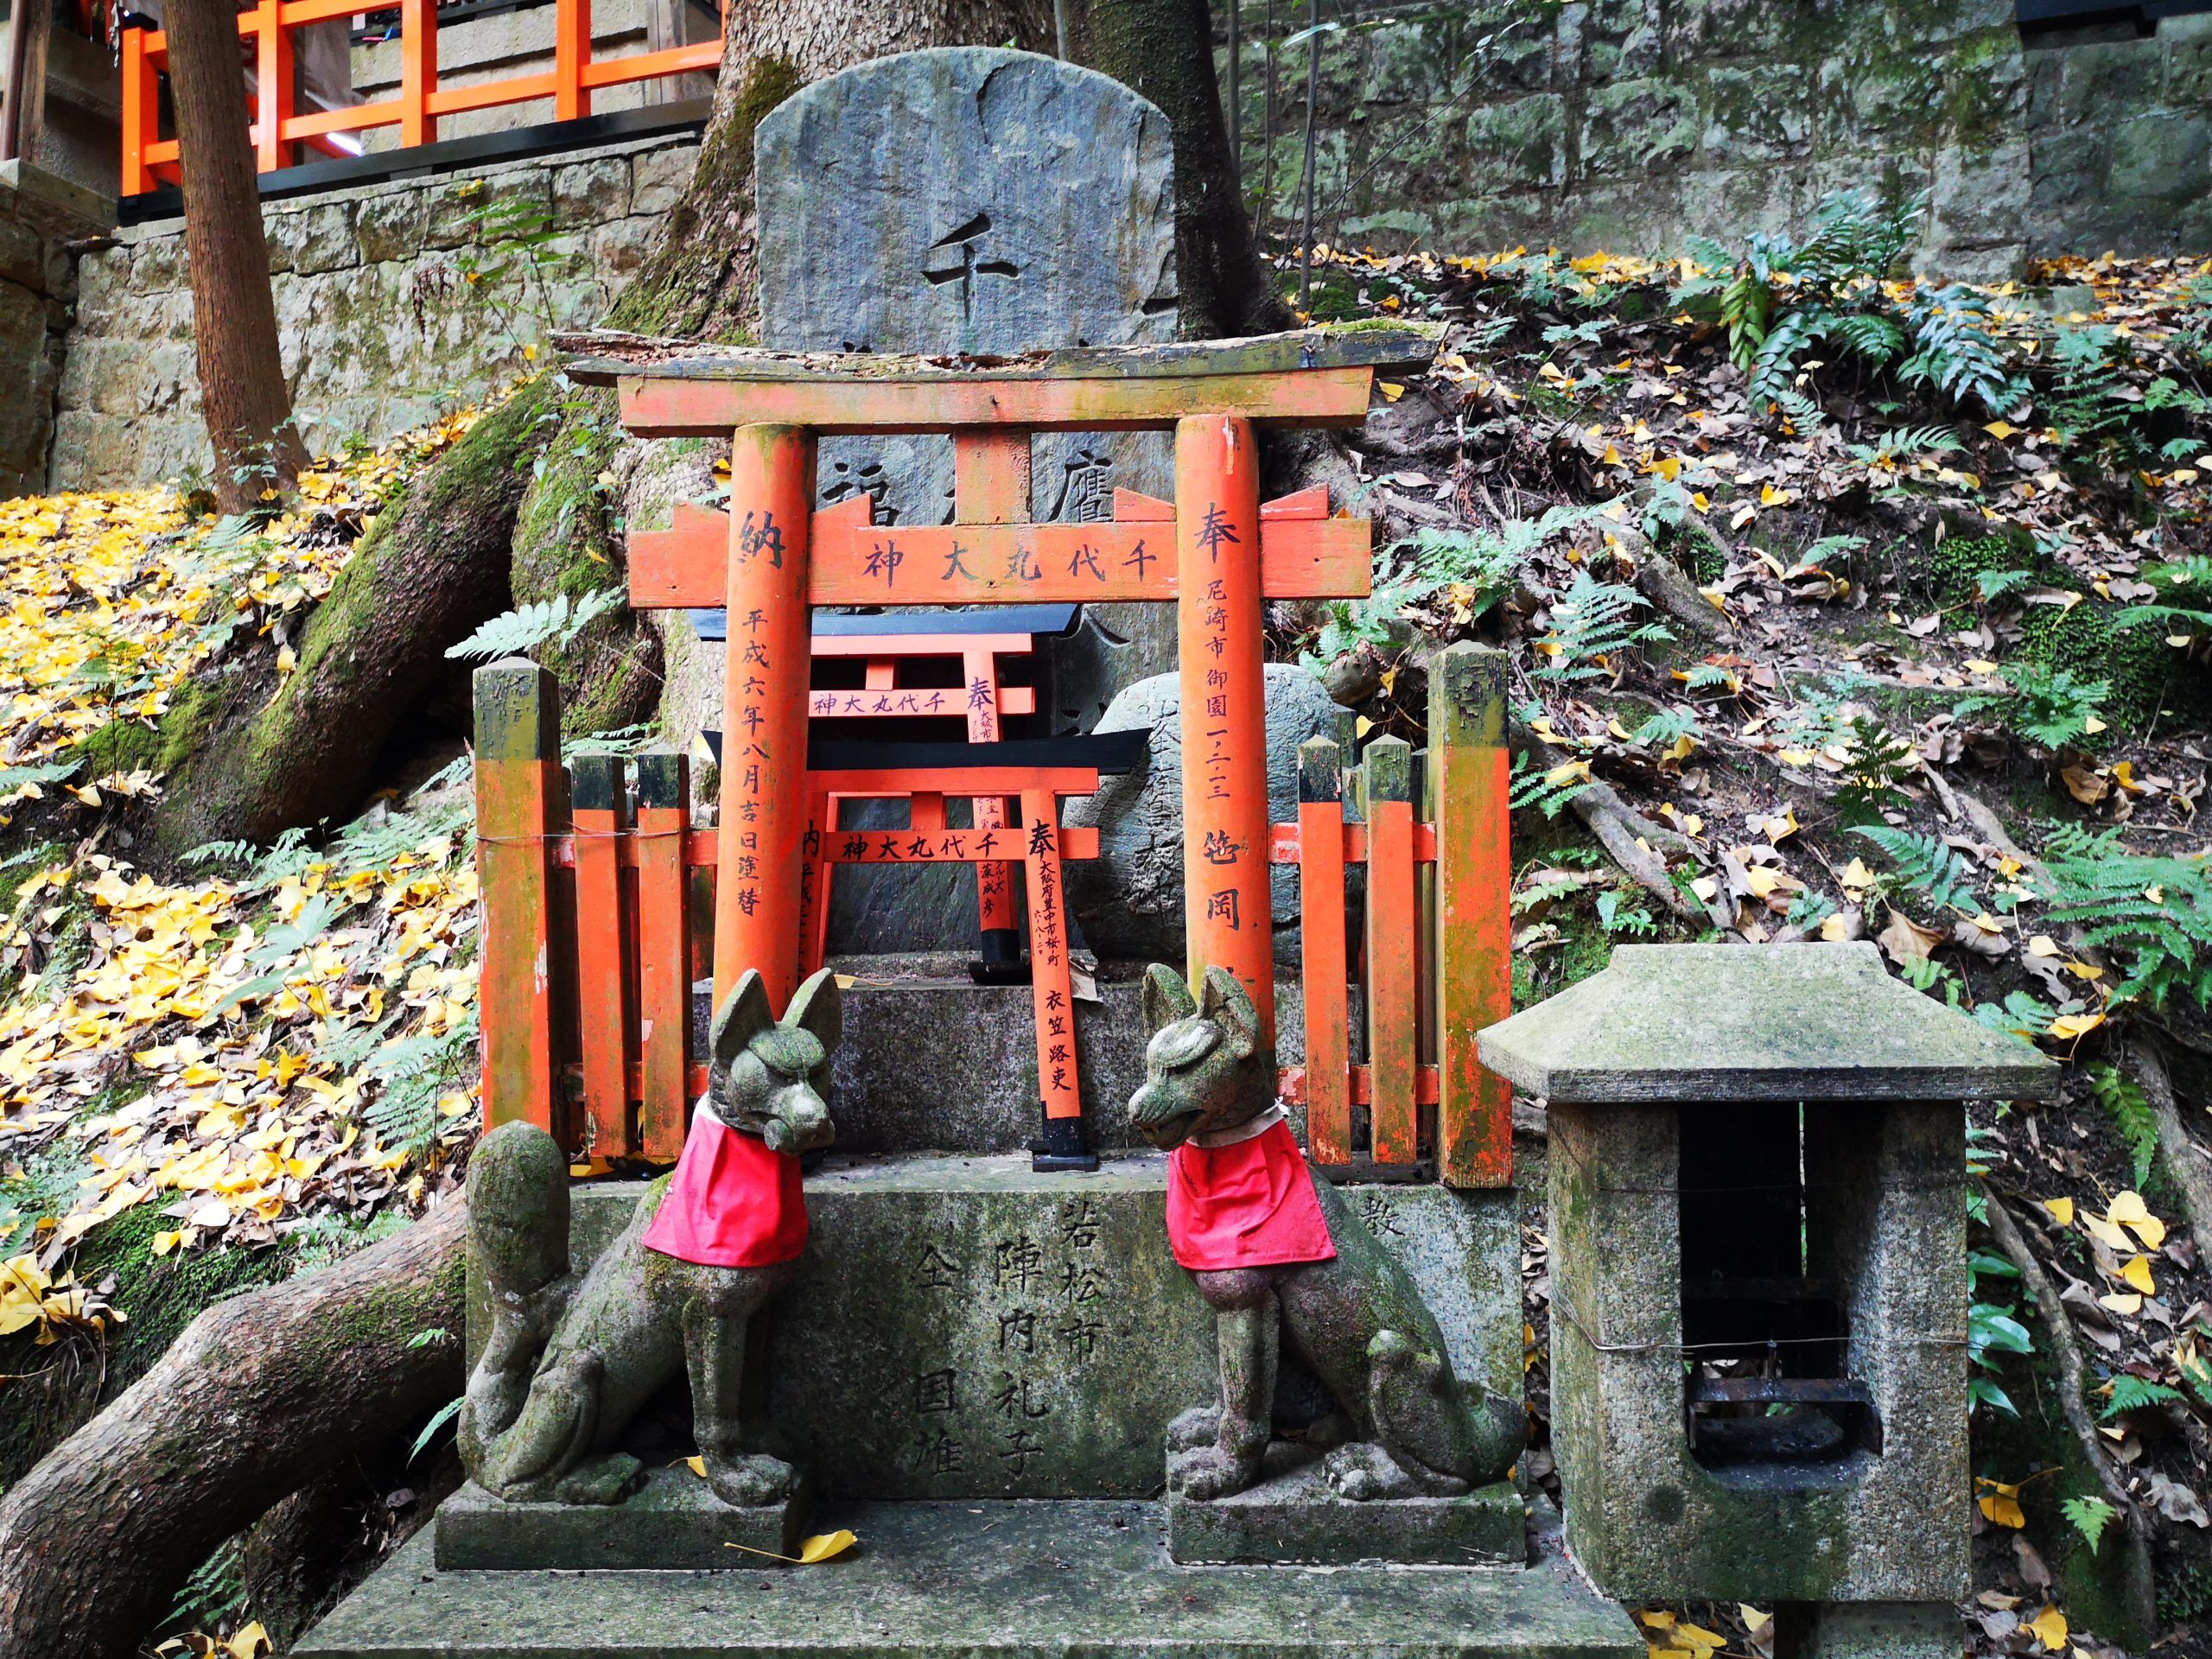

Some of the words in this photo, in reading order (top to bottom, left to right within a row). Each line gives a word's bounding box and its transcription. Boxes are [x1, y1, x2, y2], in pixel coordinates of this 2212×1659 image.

[1193, 502, 1241, 564] 奉
[1029, 819, 1056, 861] 奉
[1202, 829, 1242, 977] 笹岡
